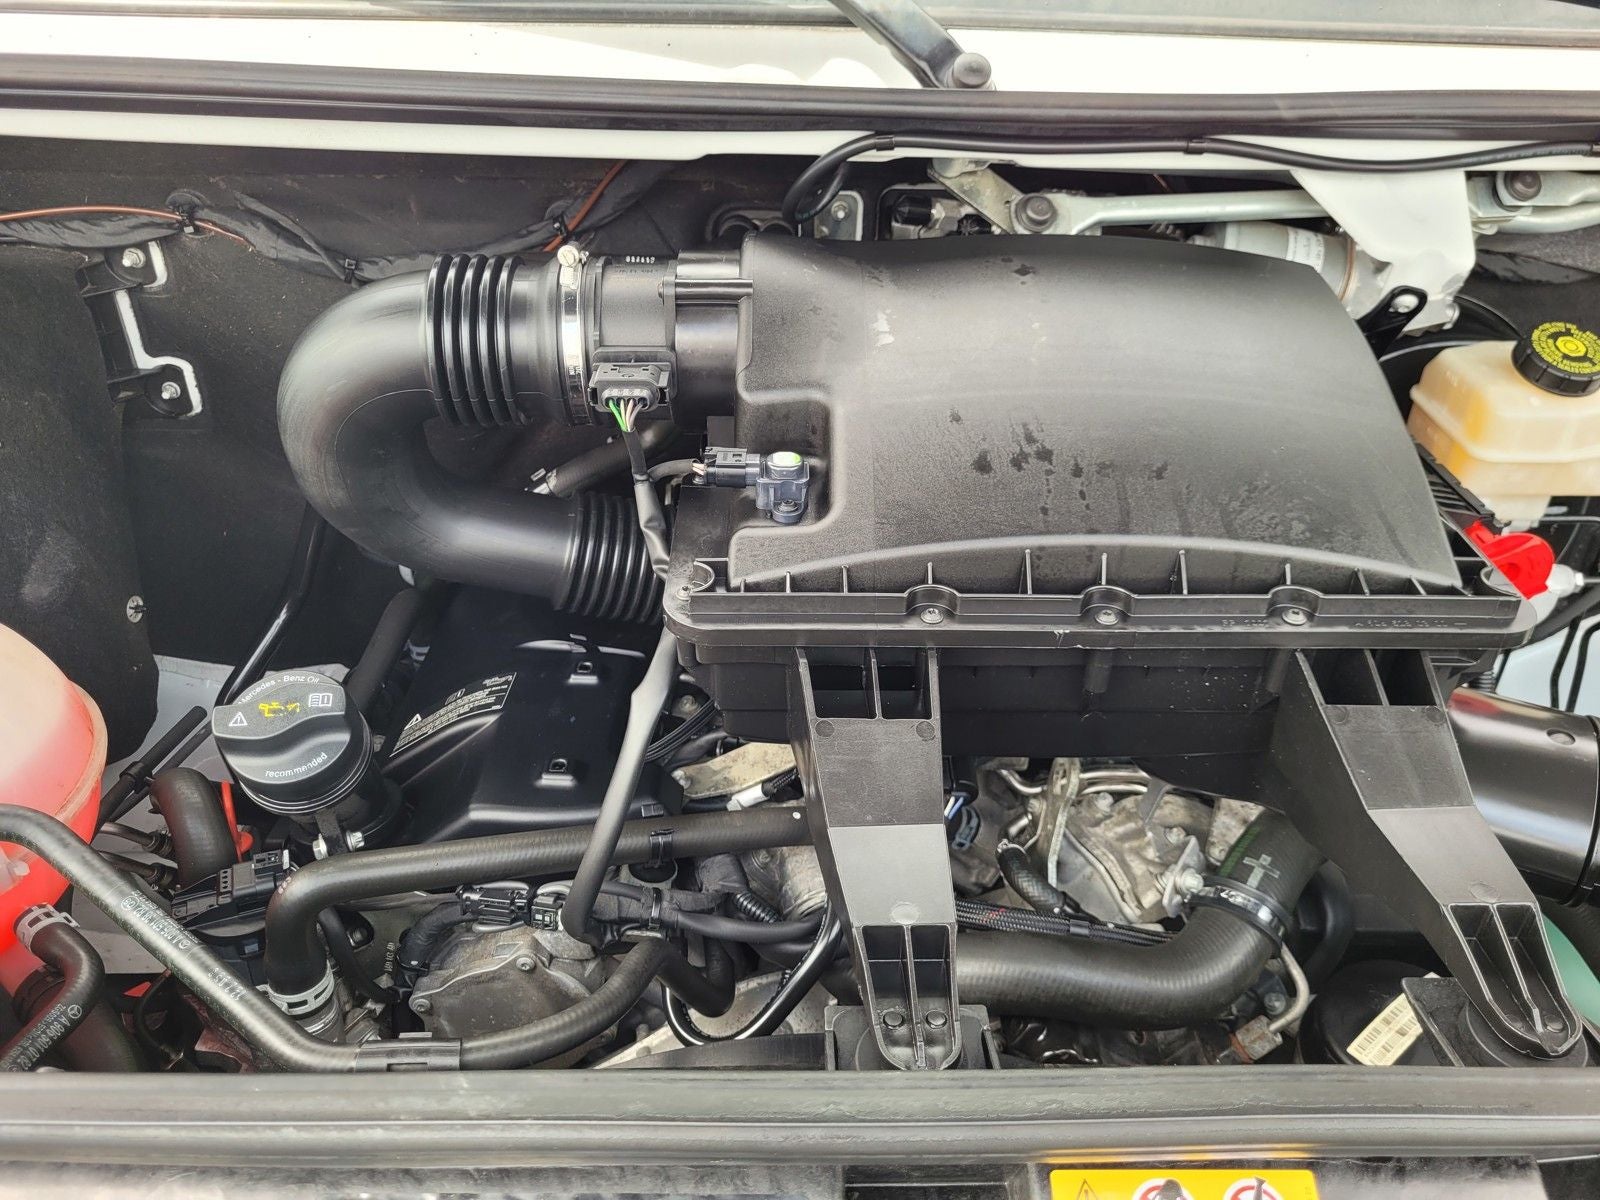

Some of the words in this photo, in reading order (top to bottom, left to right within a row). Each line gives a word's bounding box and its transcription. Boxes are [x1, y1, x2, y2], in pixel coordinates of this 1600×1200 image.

[283, 674, 306, 683] Benz
[307, 675, 320, 684] Oil
[265, 751, 328, 778] recommended
[57, 1013, 72, 1027] A
[32, 1032, 53, 1053] 501
